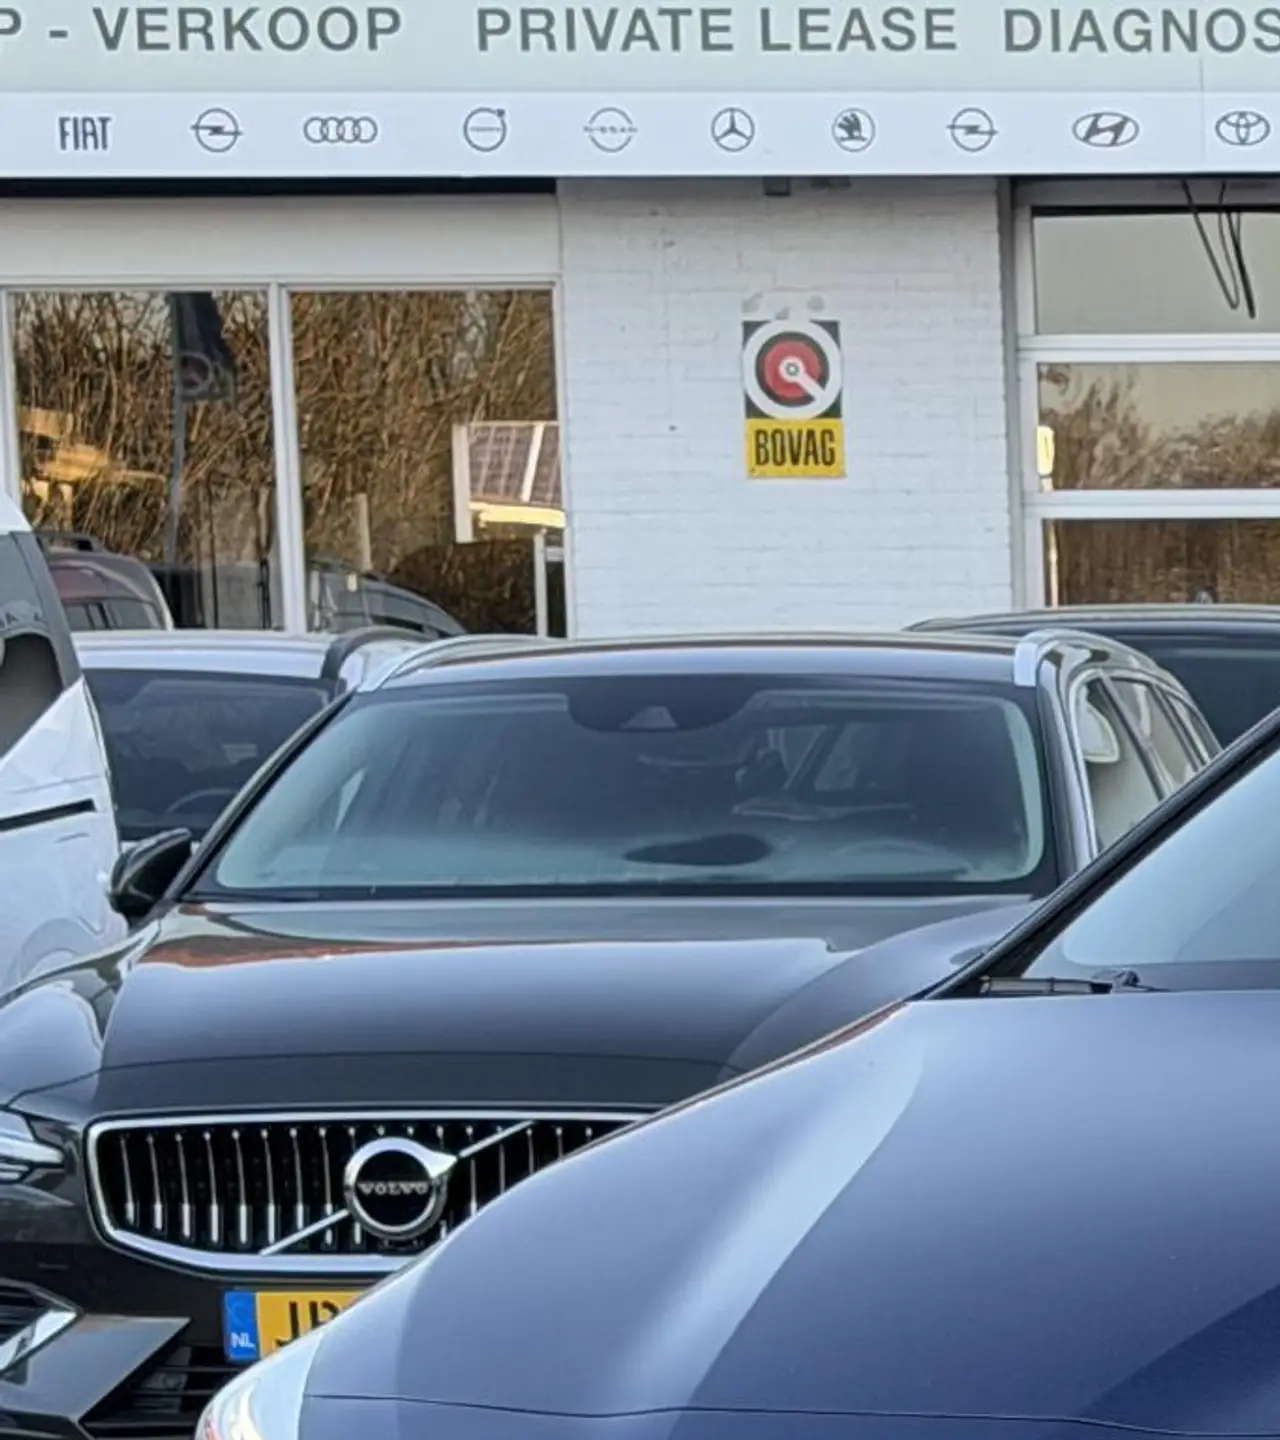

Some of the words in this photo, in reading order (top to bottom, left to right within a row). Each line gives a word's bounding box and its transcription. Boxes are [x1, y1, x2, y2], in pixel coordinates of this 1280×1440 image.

[92, 7, 401, 51] VERKOOP
[477, 7, 734, 52] PRIVATE
[760, 7, 957, 52] LEASE
[59, 117, 111, 150] FIAT
[755, 428, 836, 467] BOVAG
[357, 1180, 429, 1197] VOLVO
[231, 1331, 256, 1349] NL
